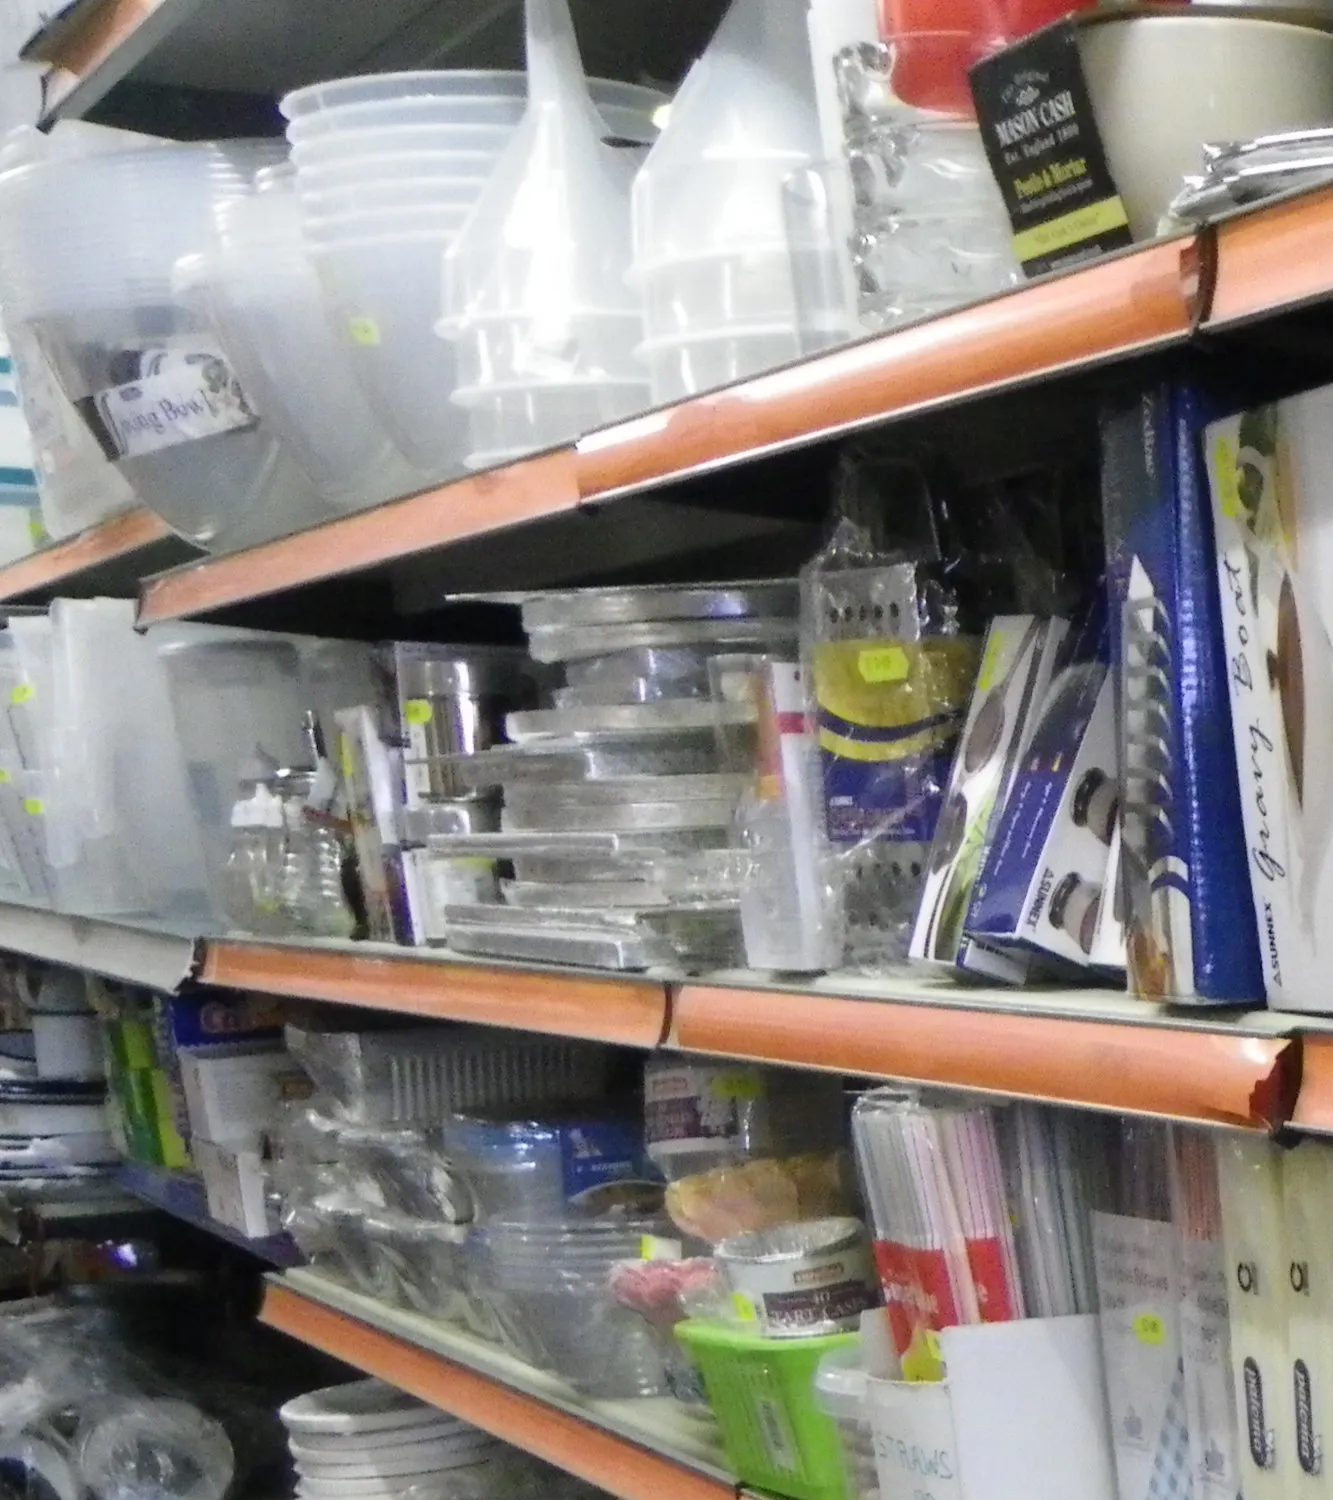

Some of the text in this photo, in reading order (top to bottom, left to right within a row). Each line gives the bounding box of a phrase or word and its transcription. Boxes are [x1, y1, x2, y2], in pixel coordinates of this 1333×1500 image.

[995, 90, 1075, 145] MASON CASH
[876, 1431, 953, 1480] STRAWS
